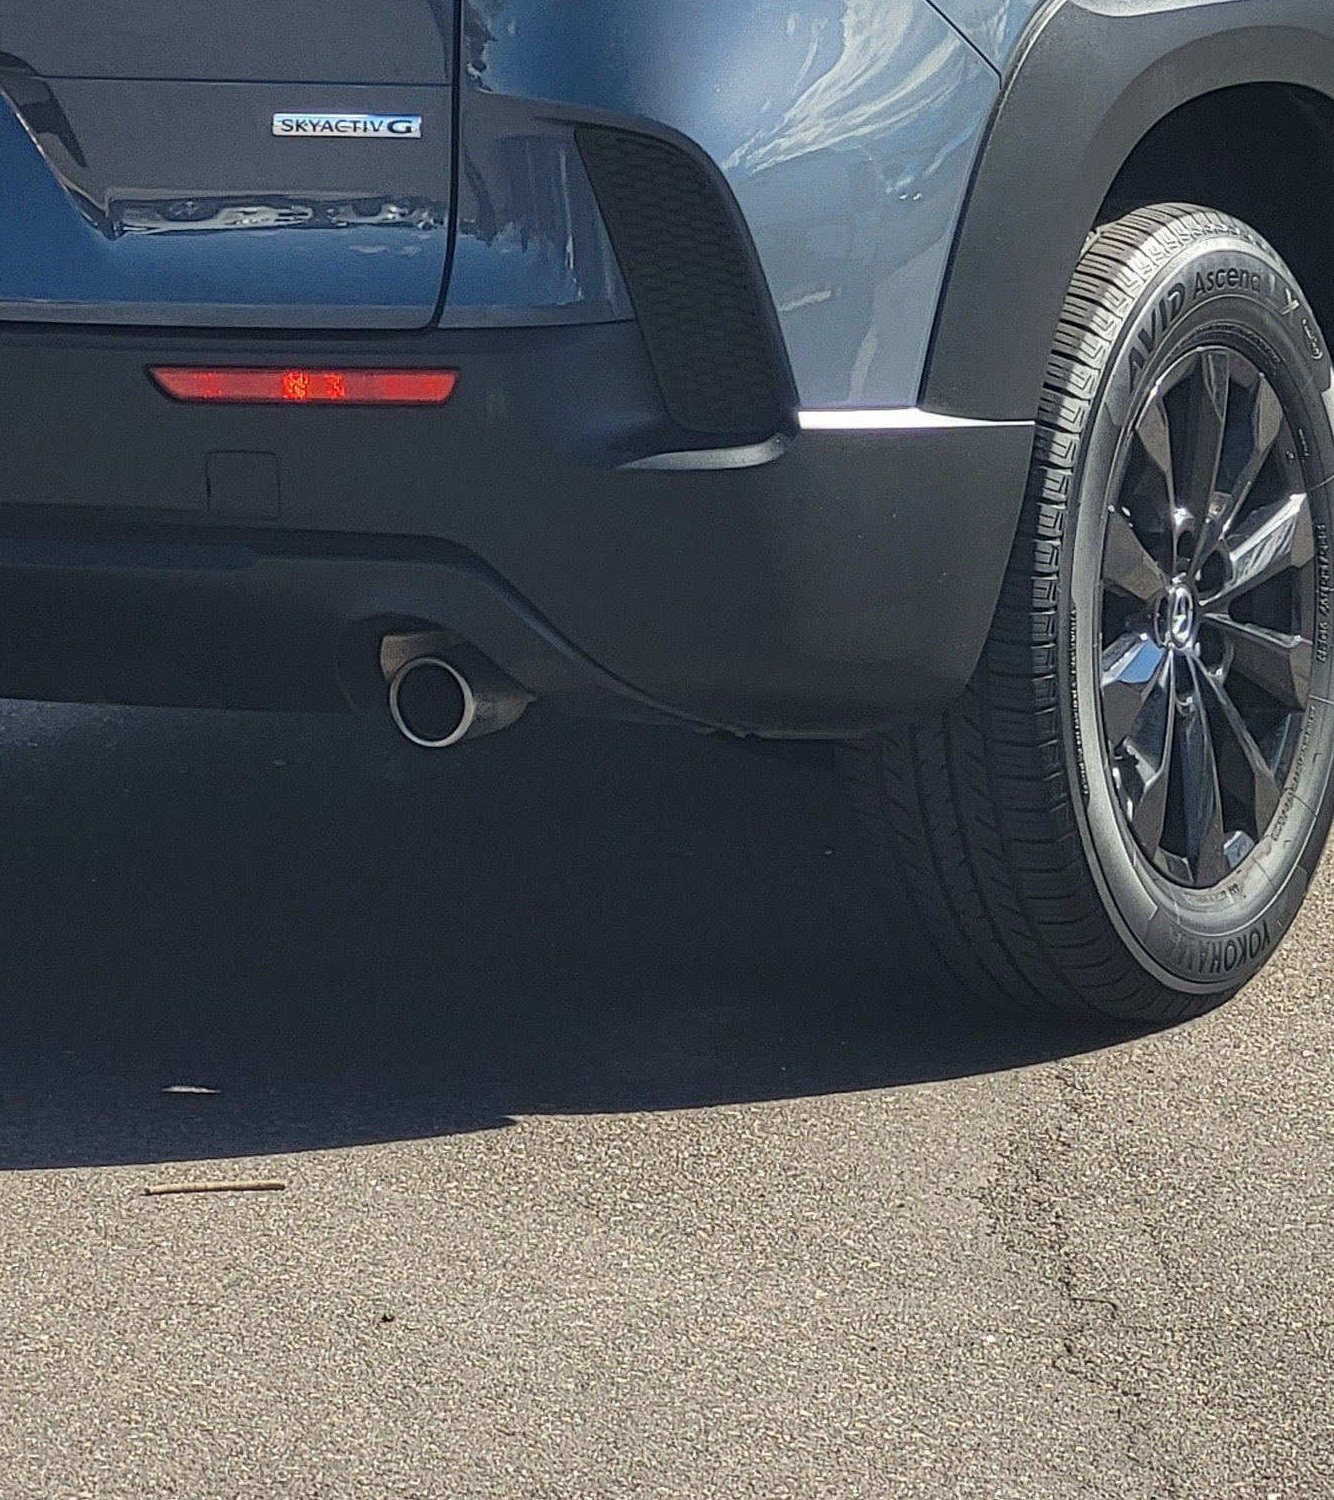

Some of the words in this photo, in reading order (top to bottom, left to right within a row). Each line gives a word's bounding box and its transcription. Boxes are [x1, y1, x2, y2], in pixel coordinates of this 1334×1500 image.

[280, 118, 383, 133] SKYACTIV
[386, 119, 414, 134] G
[1128, 282, 1187, 392] AVID
